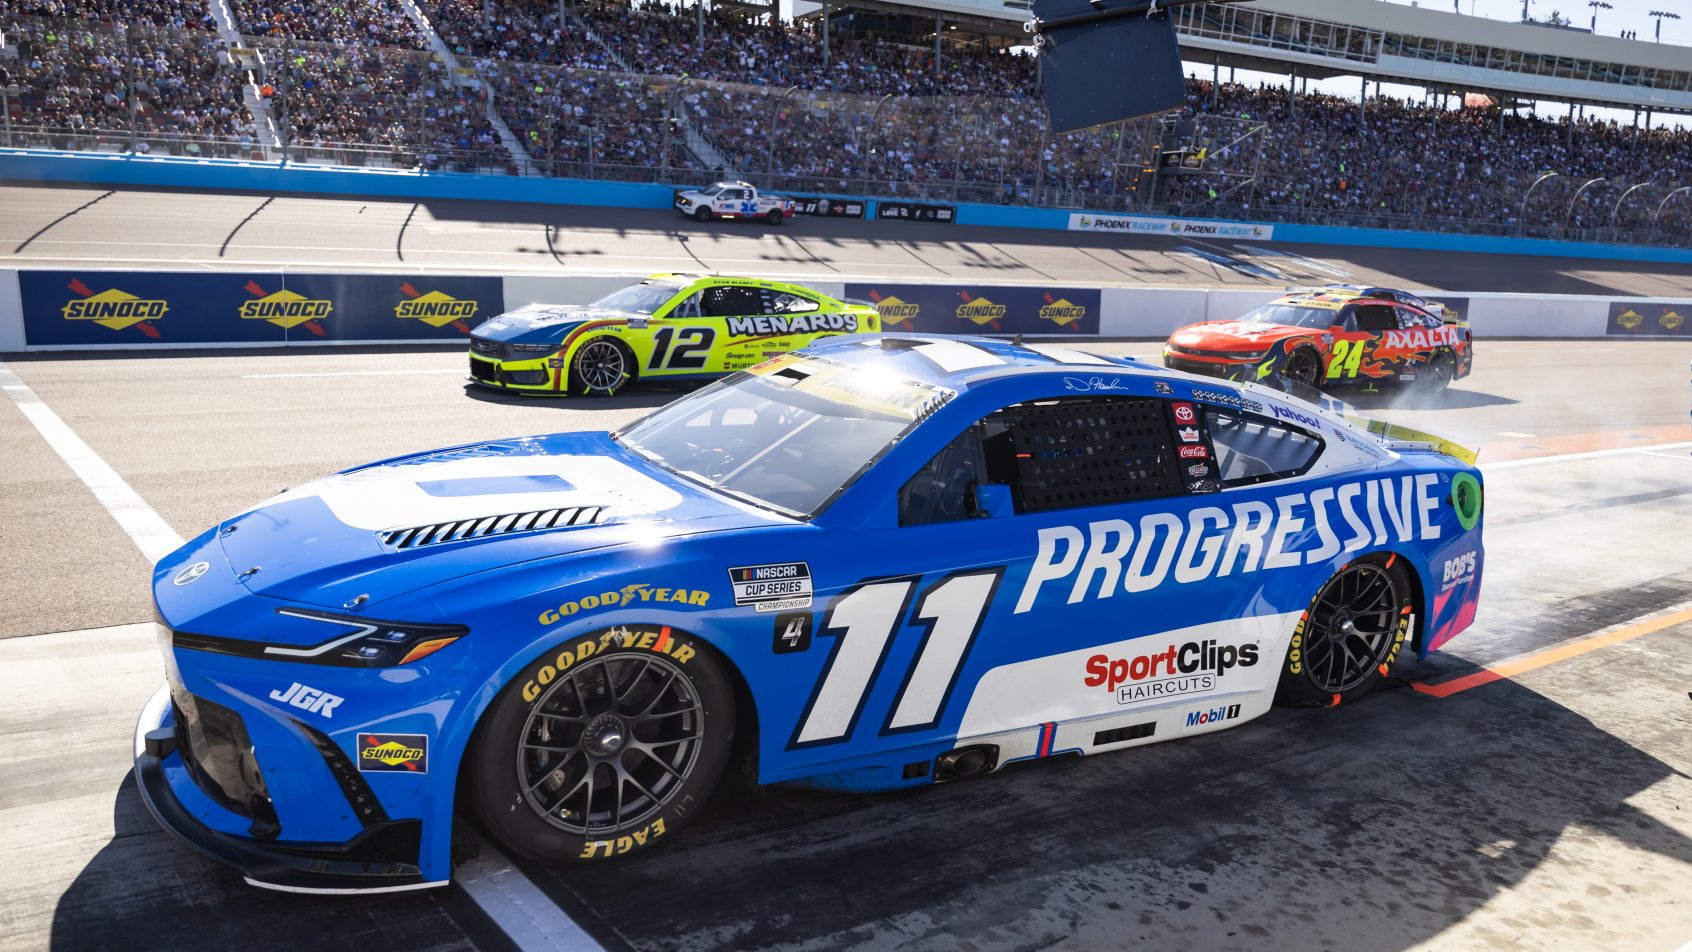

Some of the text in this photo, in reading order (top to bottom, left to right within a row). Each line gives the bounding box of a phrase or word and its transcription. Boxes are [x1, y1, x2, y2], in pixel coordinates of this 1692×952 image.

[1094, 218, 1168, 232] PHOENIX RACEWAY
[1184, 224, 1253, 236] PHOENIX RACEWAY
[67, 301, 166, 318] SUNOCO
[243, 301, 330, 318] SUNOCO
[397, 301, 476, 318] SUNOCO
[878, 305, 918, 318] UNOCO
[957, 306, 1005, 318] SUNOCO
[1041, 307, 1084, 319] SUNOCO
[727, 314, 858, 336] MENARDS
[646, 326, 715, 371] 12
[1384, 326, 1460, 349] AXALTA
[725, 352, 755, 360] Snap-on
[1326, 339, 1366, 379] 24
[1268, 403, 1321, 429] yahoo!
[1013, 472, 1442, 615] PROGRESSIVE
[756, 566, 797, 579] NASCAR
[1443, 550, 1477, 582] BOB'S
[745, 581, 802, 596] CUP SERIES
[538, 585, 710, 626] GOODYEAR
[757, 598, 810, 611] CHAMPIONSHIP
[781, 617, 805, 647] 4
[521, 630, 696, 703] GOODYEAR
[784, 567, 1006, 752] 11
[1084, 639, 1259, 693] SportClips
[269, 681, 345, 719] JGR
[1120, 676, 1212, 702] HAIRCUTS
[1186, 706, 1226, 727] Mobil
[364, 748, 422, 760] SUNOCO
[579, 815, 667, 859] EAGLE
